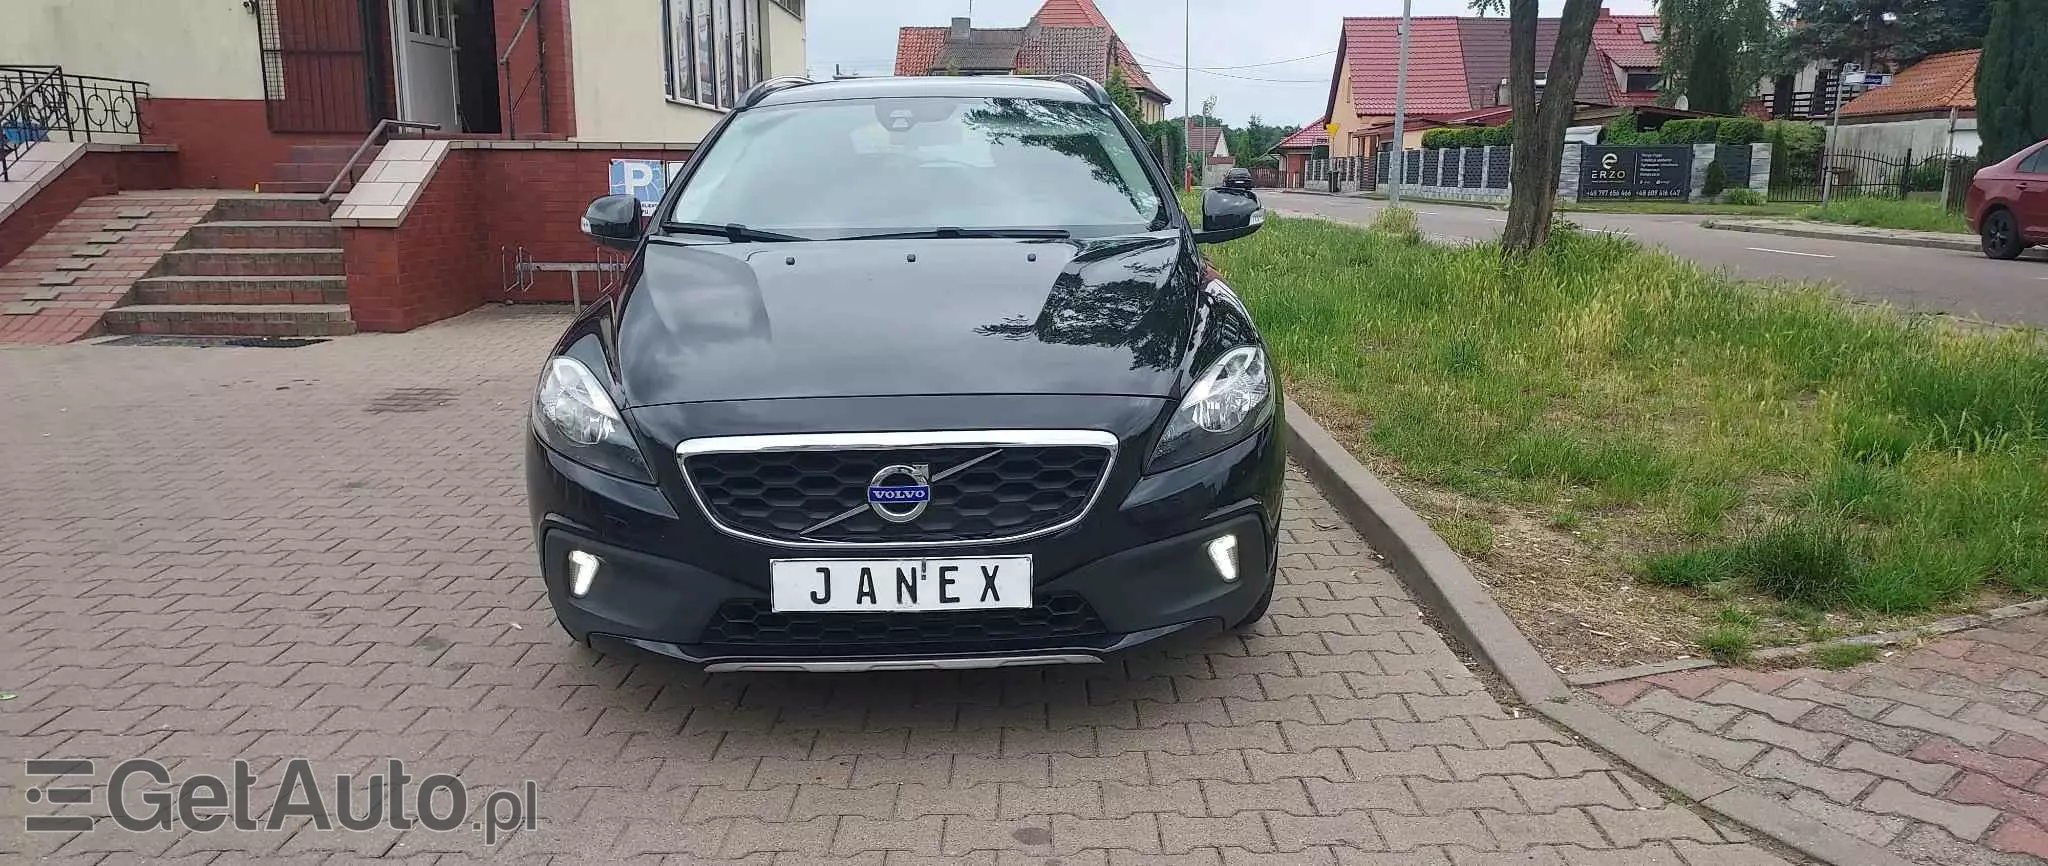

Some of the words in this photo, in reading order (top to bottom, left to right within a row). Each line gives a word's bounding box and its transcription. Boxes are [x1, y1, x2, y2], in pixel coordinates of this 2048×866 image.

[624, 162, 653, 196] P
[1591, 170, 1626, 179] ERZO
[873, 490, 926, 499] VOLVO
[810, 565, 1001, 605] JANEX
